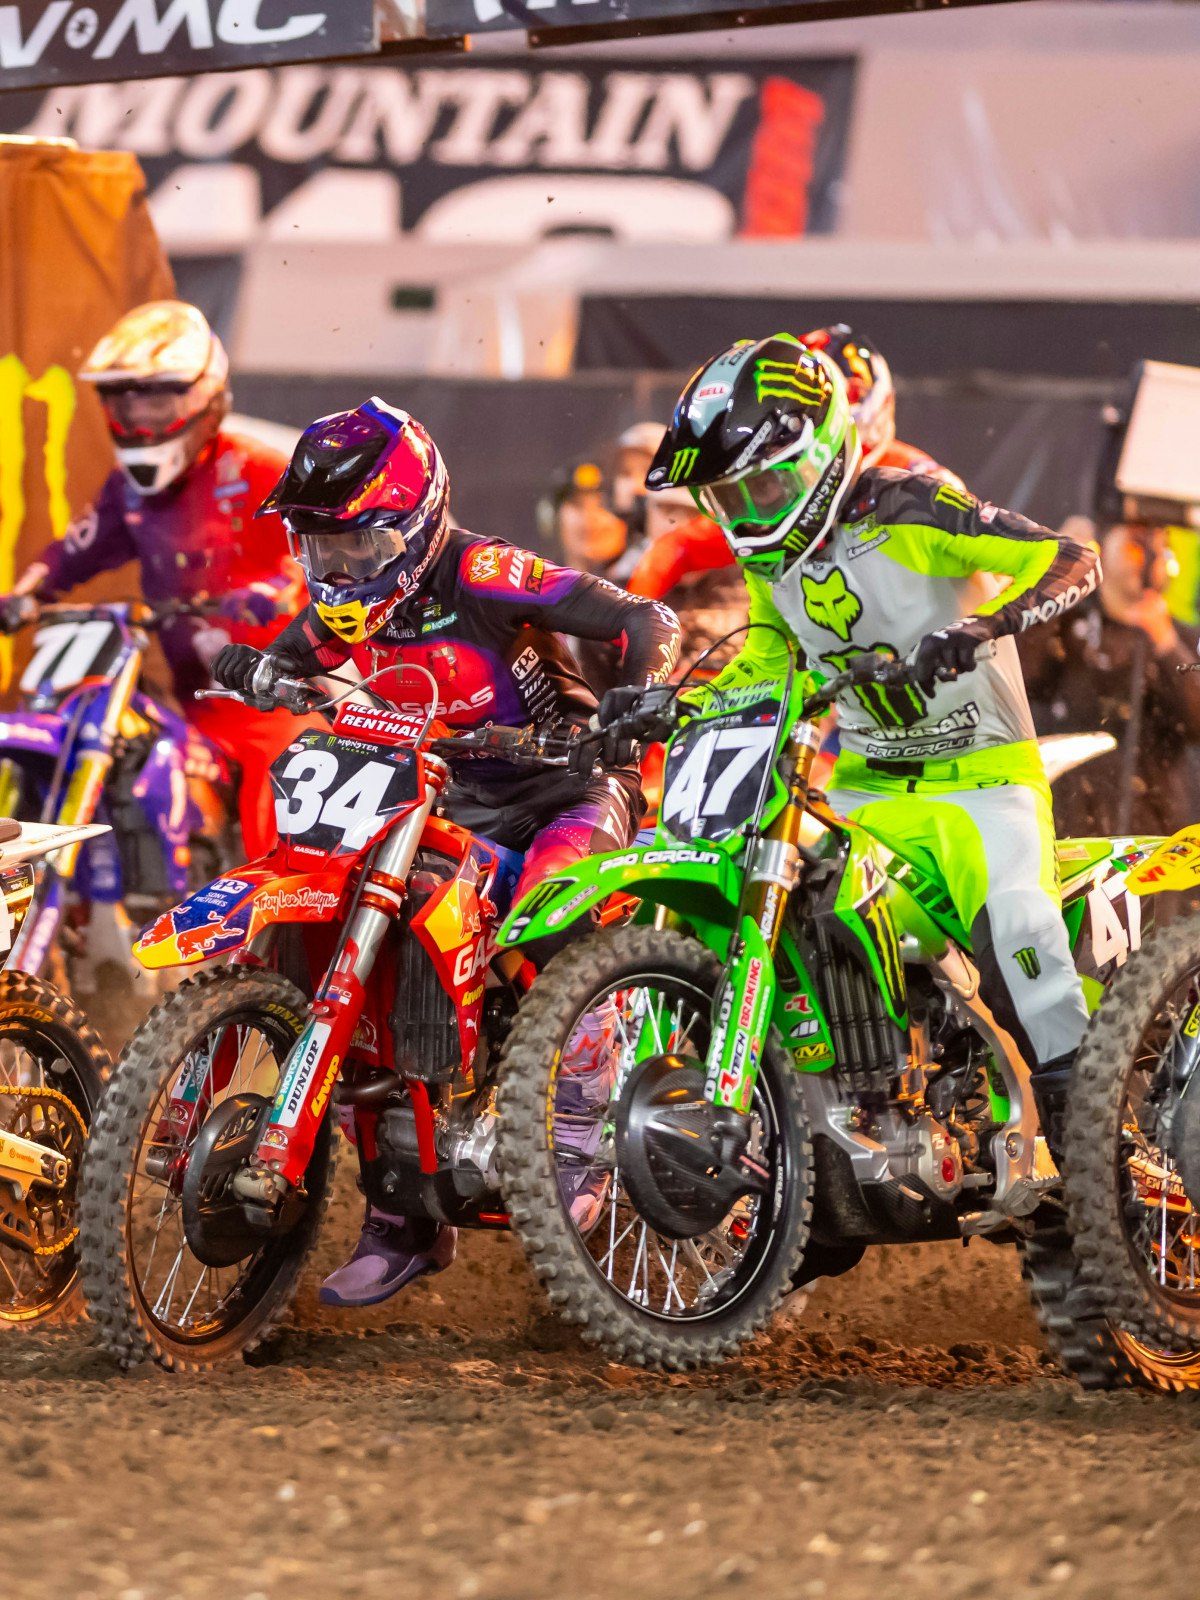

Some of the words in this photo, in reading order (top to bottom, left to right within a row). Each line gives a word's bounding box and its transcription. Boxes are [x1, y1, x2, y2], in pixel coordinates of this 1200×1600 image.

[698, 385, 725, 398] BELL
[514, 649, 537, 678] PPG
[340, 715, 422, 739] RENTHAL
[337, 738, 379, 753] MONSTER
[341, 746, 370, 756] ENERGY
[867, 744, 900, 758] PRO
[902, 736, 976, 757] CIRCUIT
[662, 725, 778, 825] 47
[274, 749, 397, 851] 34
[293, 846, 326, 858] GASGAS
[205, 891, 228, 900] SONY
[254, 890, 280, 916] Troy
[279, 888, 298, 909] Lee
[297, 887, 340, 915] Designs
[738, 957, 762, 1028] BRAKING
[703, 981, 736, 1102] DUNLOP
[287, 1039, 320, 1115] DUNLOP
[405, 1070, 420, 1081] Twin
[420, 1073, 430, 1082] Air
[1146, 1174, 1187, 1199] ENTHAL
